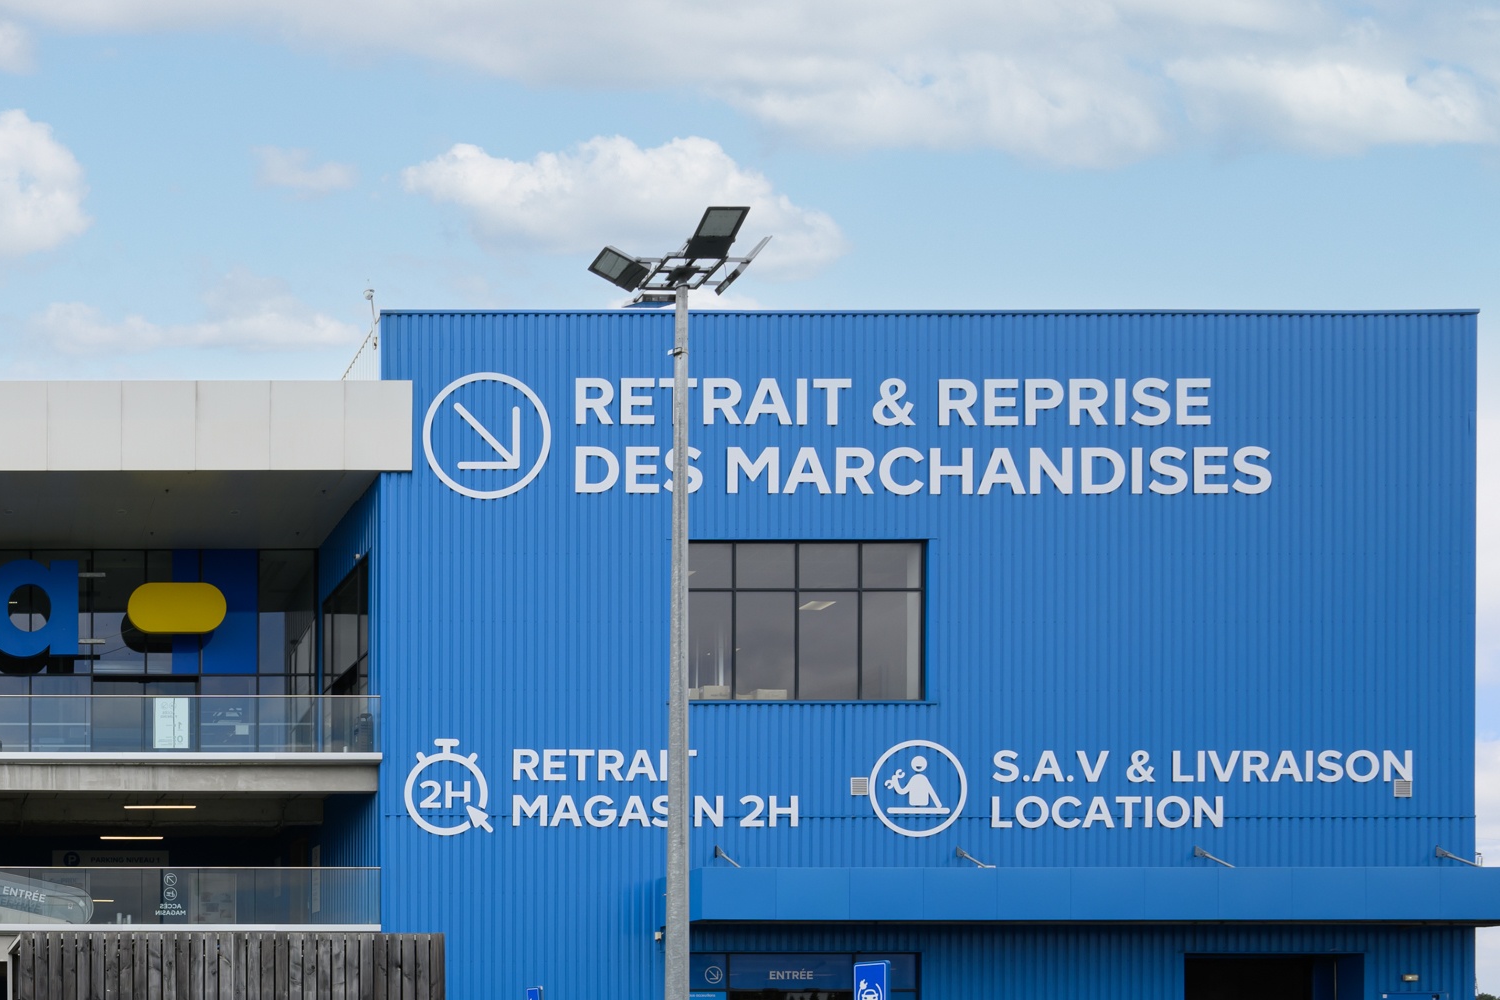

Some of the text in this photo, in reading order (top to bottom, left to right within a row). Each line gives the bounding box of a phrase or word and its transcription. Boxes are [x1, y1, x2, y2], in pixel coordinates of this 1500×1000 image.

[872, 377, 916, 427] &
[938, 377, 1212, 427] REPRISE
[575, 445, 1273, 496] DES MARCHANDISES
[512, 748, 698, 782] RETRAI
[992, 749, 1414, 783] S.A.V & LIVRAISON
[419, 780, 471, 809] 2H
[512, 794, 800, 828] MAGASN 2H
[991, 795, 1224, 829] LOCATION
[90, 856, 123, 864] PARKING
[125, 856, 155, 864] NIVEAU
[2, 885, 47, 903] ENTRÉE
[769, 968, 814, 980] ENTRÉE
